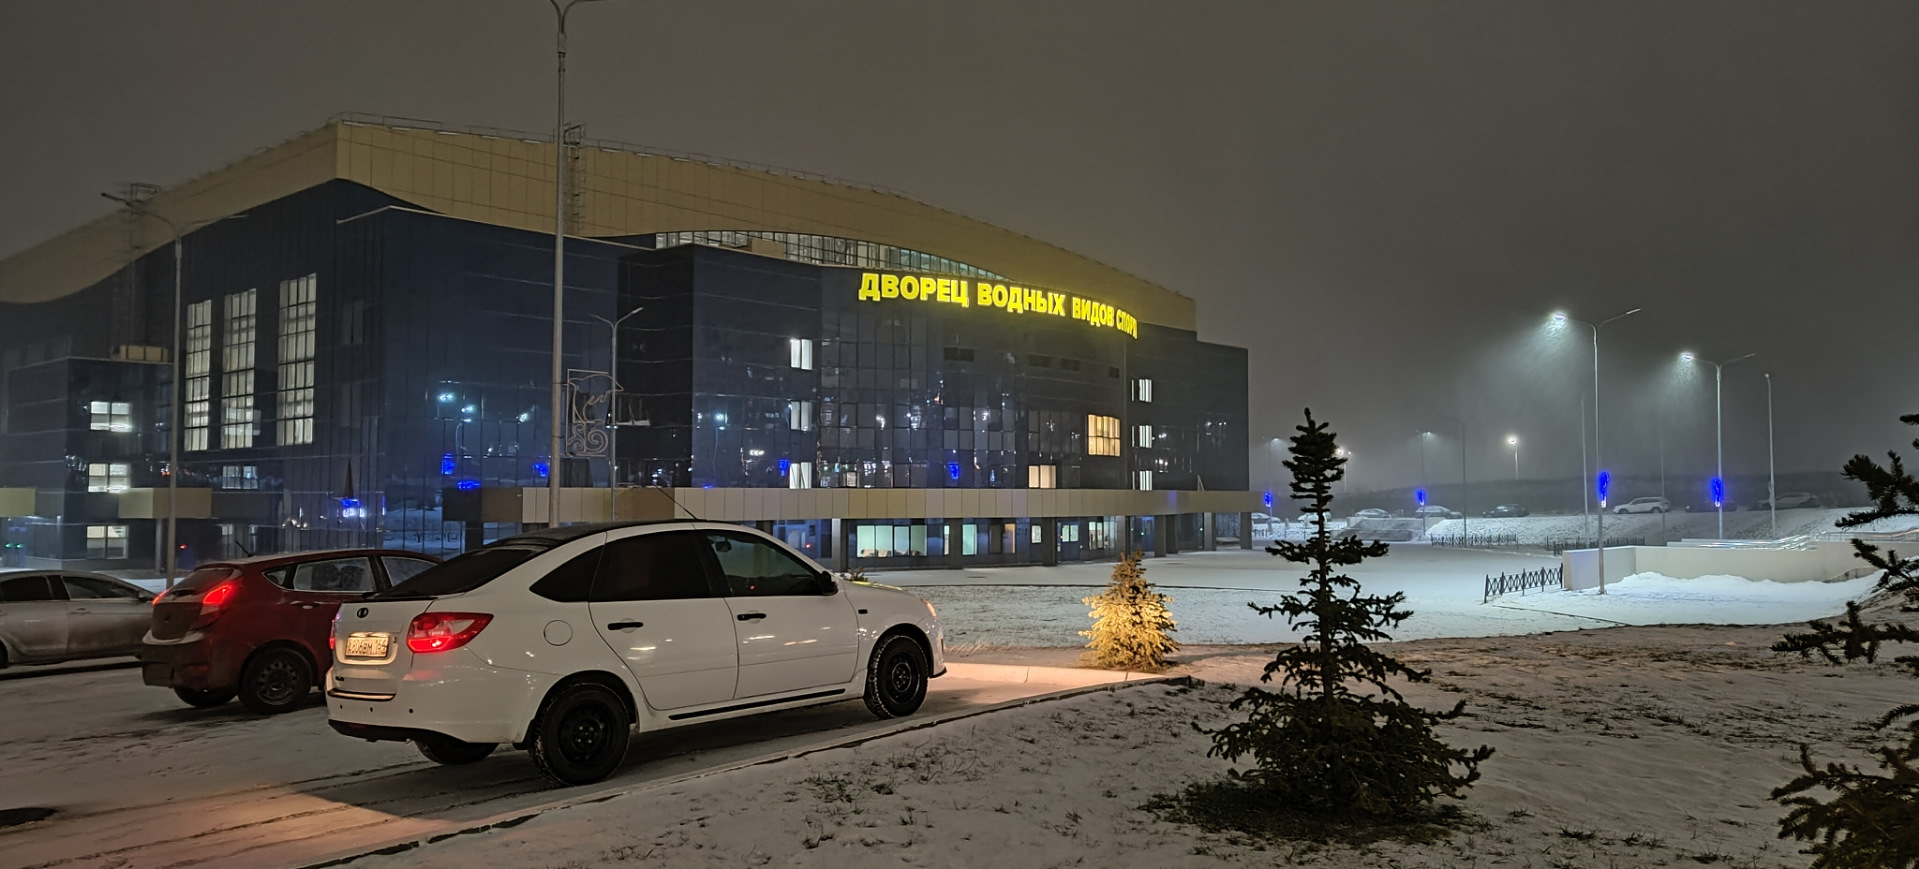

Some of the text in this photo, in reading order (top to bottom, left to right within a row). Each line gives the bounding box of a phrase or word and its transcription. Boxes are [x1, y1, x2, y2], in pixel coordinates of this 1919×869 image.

[858, 272, 970, 308] ДВОРЕЦ
[977, 282, 1066, 317] ВОДНЫХ
[1072, 296, 1115, 328] ВИДОВ
